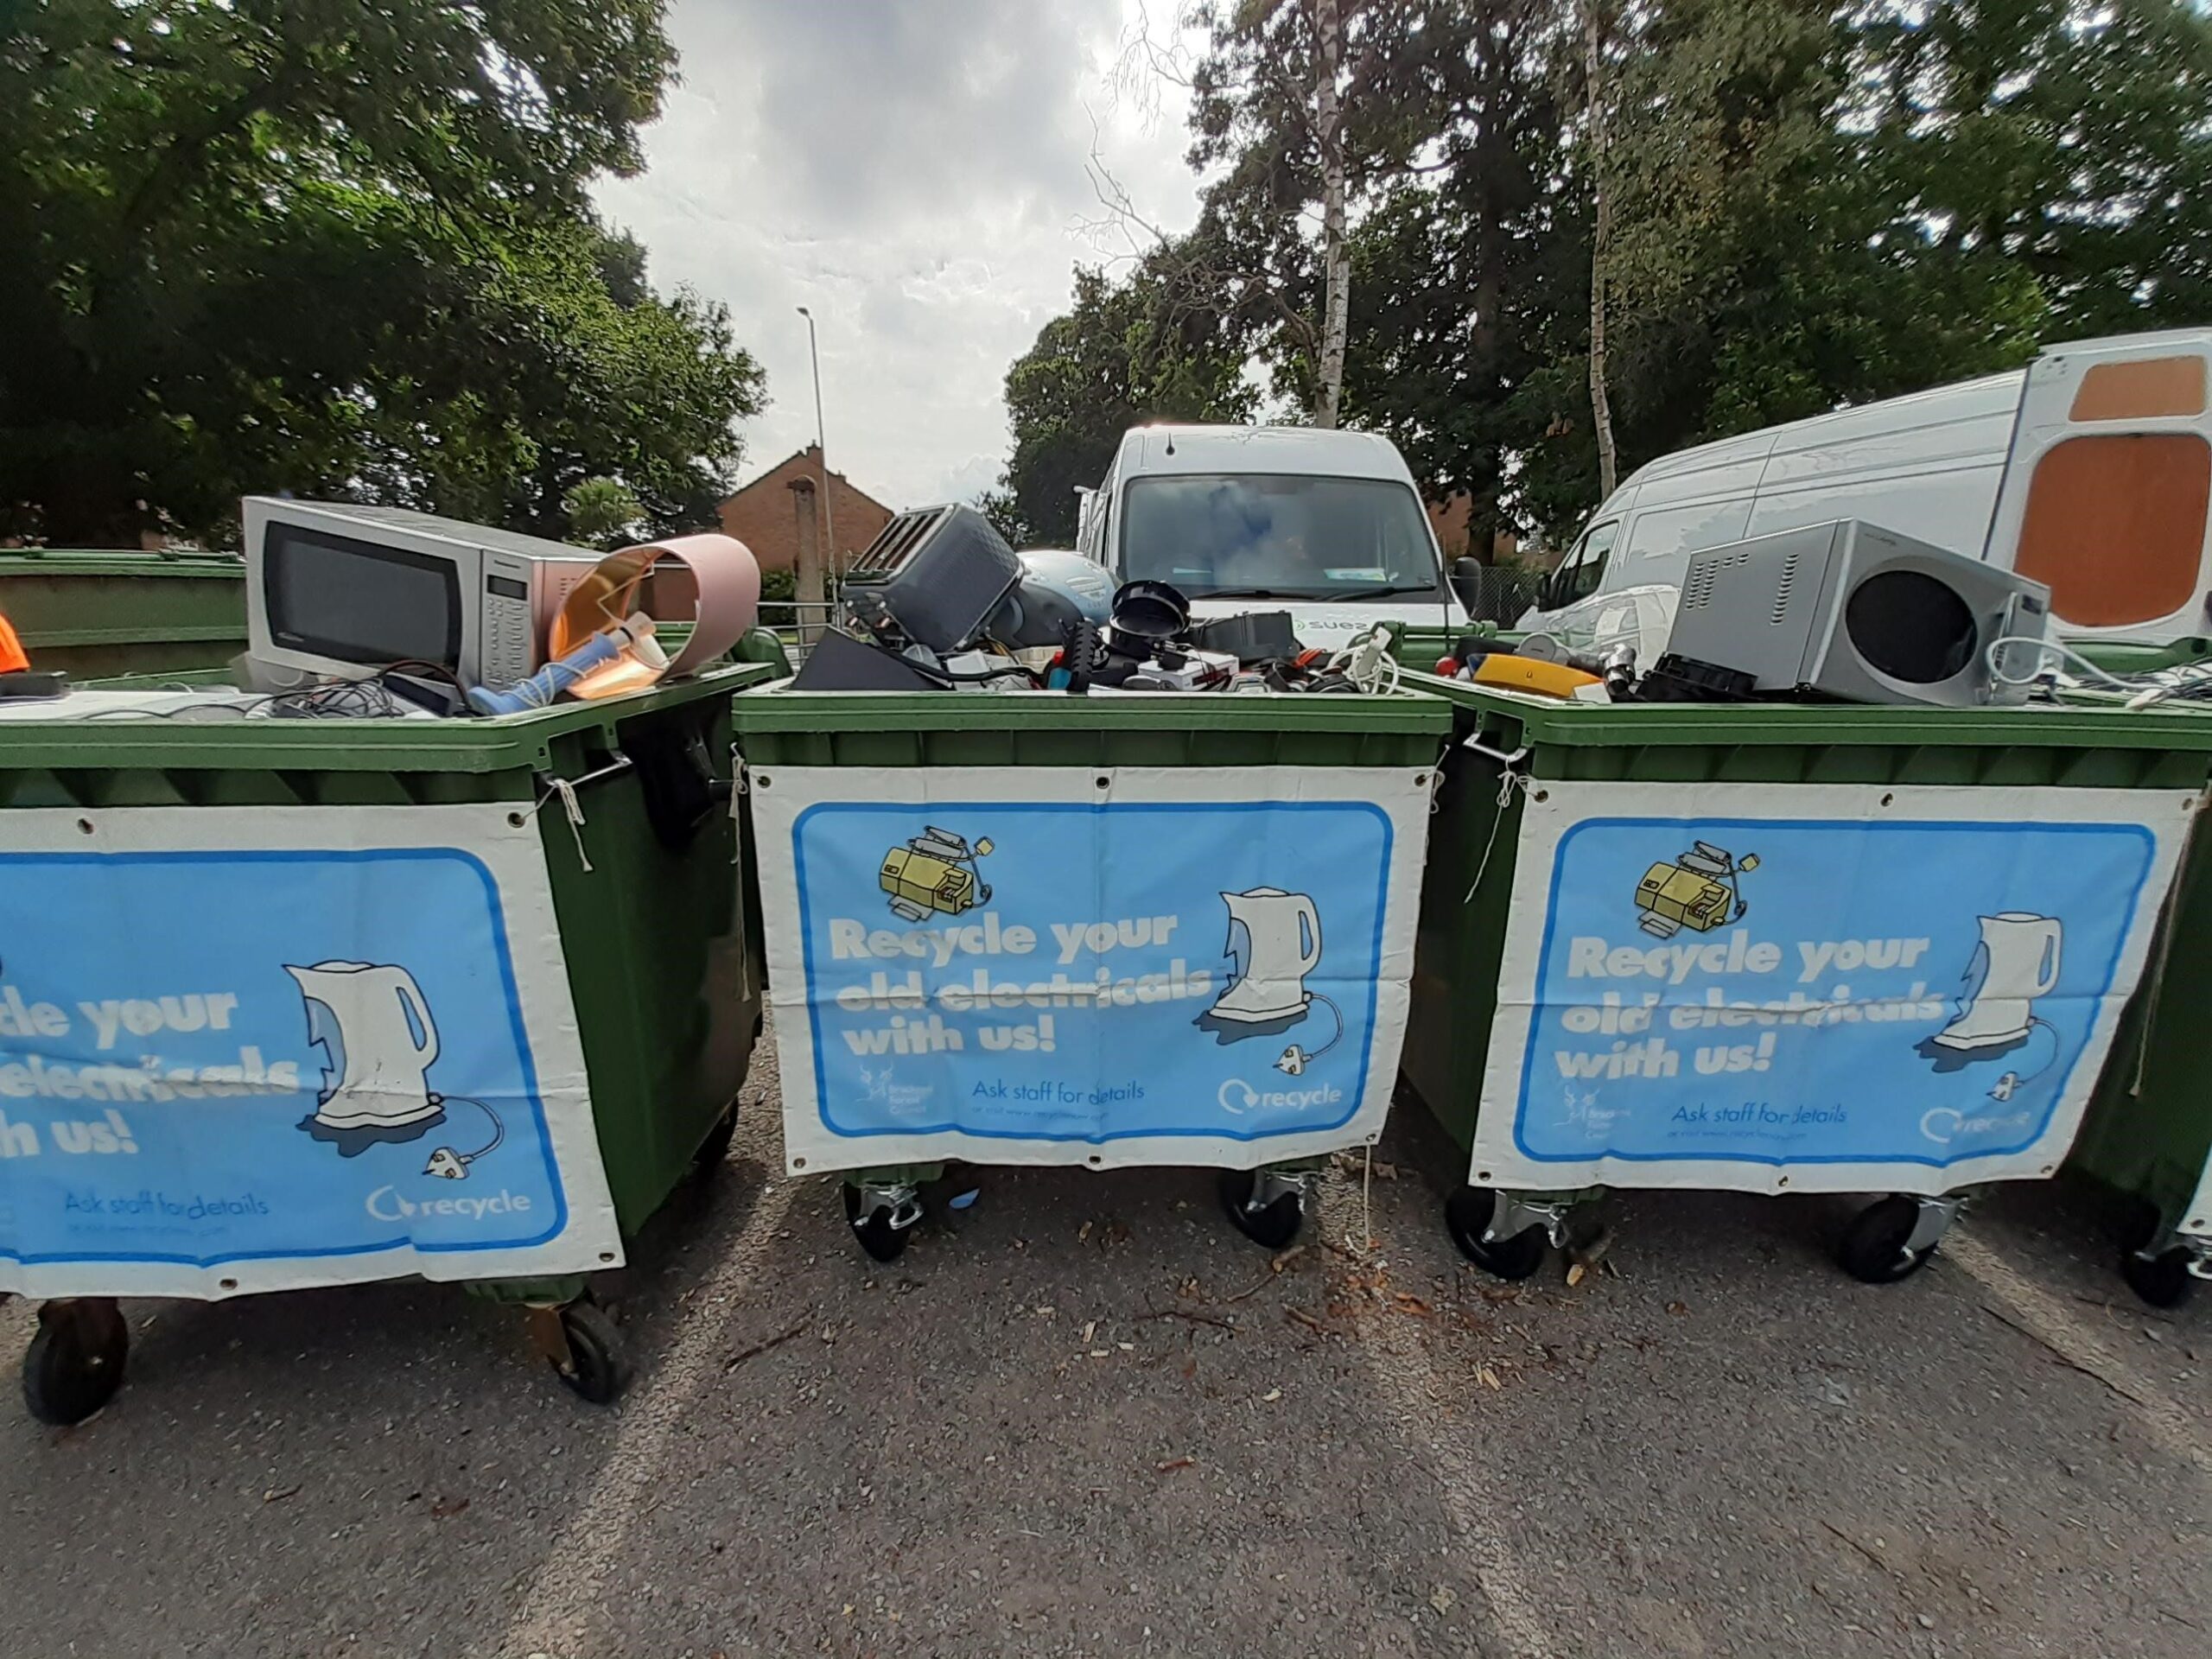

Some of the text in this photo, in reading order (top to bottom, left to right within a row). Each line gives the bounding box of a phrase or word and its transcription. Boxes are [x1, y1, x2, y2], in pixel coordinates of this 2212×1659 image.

[1308, 620, 1370, 631] suez
[828, 912, 1179, 968] Recycle your
[1567, 929, 1930, 985] Recycle your
[836, 958, 1212, 1012] old electricals
[78, 992, 238, 1050] your
[1560, 991, 1661, 1035] old
[841, 1014, 1057, 1056] with us!
[1555, 1032, 1777, 1079] with us!
[972, 1078, 1145, 1105] Ask staff for details
[1262, 1083, 1342, 1111] recycle
[1671, 1102, 1709, 1122] Ask
[1713, 1102, 1757, 1123] staff
[1758, 1102, 1790, 1123] for
[51, 1109, 139, 1154] us!
[65, 1191, 105, 1214] Ask
[187, 1191, 270, 1220] details
[421, 1188, 531, 1221] recycle
